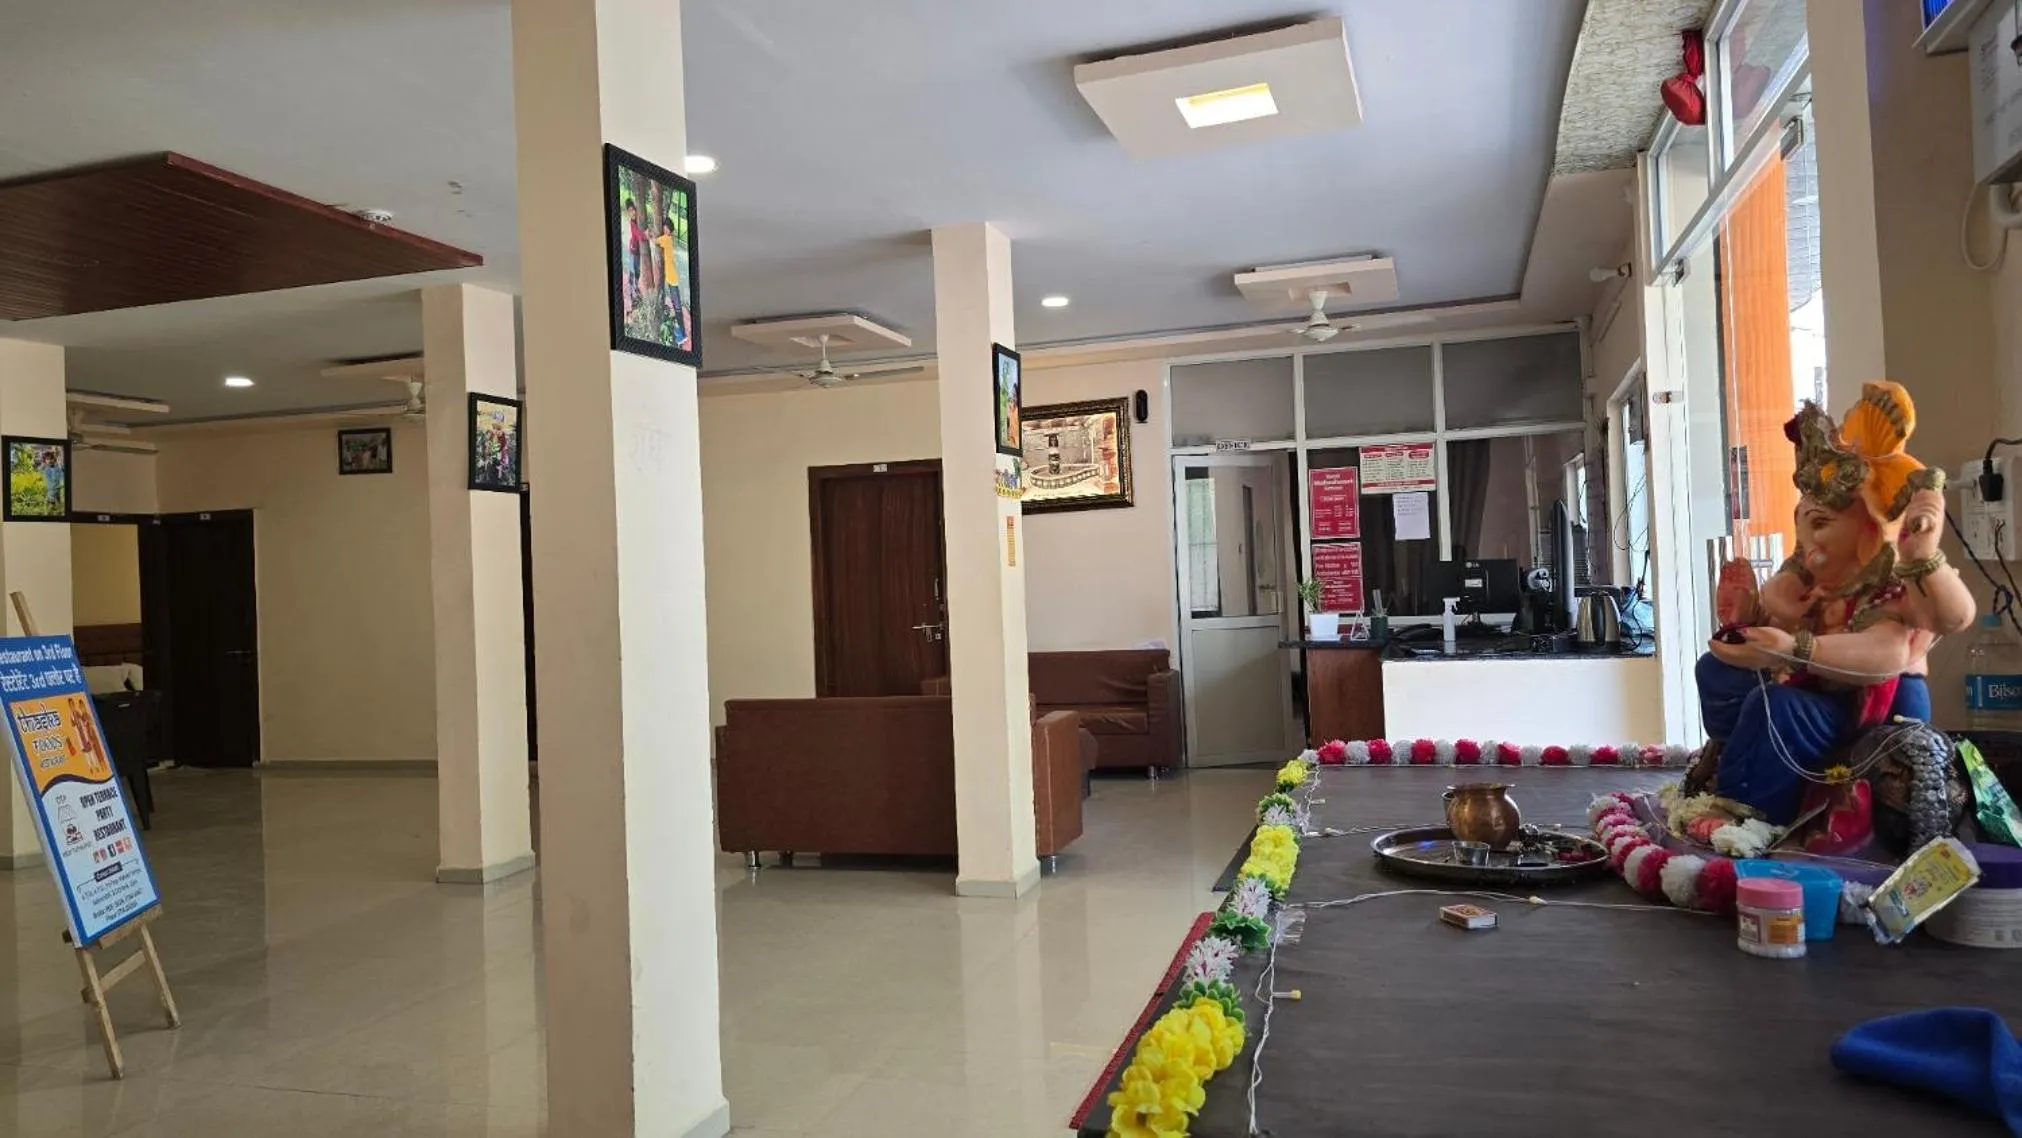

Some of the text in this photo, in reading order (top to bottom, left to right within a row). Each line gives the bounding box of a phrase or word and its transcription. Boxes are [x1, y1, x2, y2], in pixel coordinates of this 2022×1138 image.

[33, 649, 43, 661] on
[41, 644, 56, 660] 3rd
[54, 643, 73, 659] Floor
[28, 671, 47, 689] 3rd
[95, 805, 114, 821] PARTY
